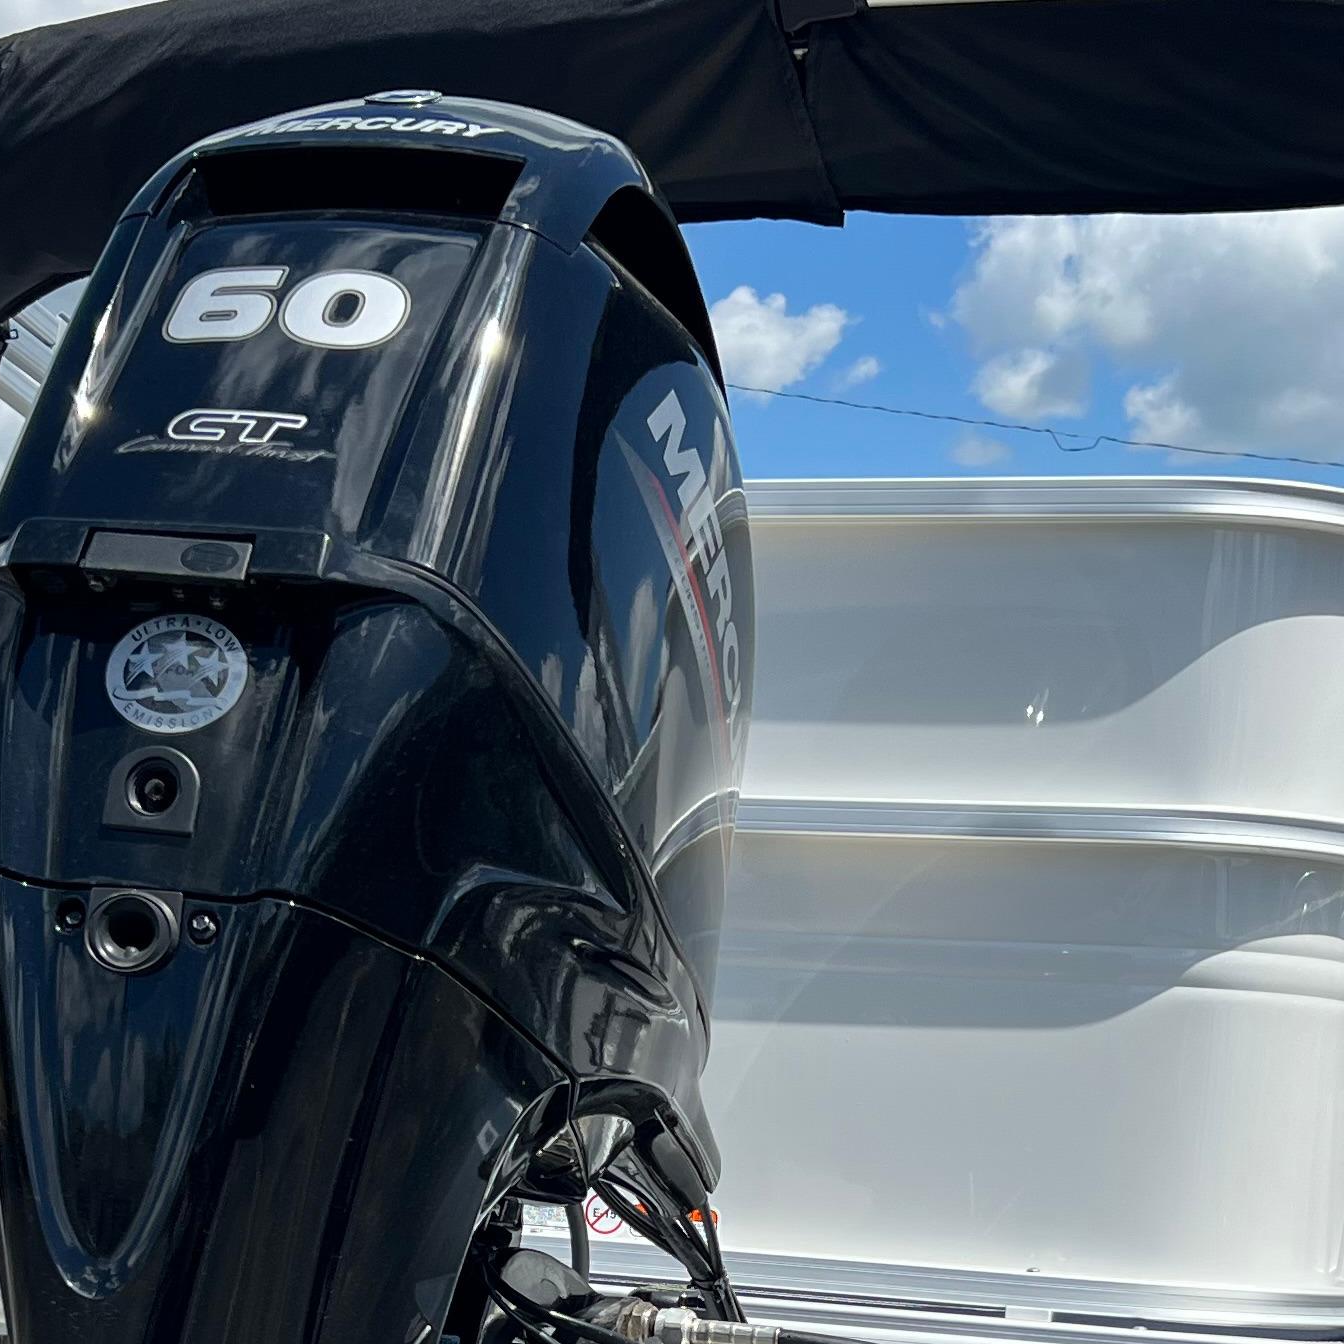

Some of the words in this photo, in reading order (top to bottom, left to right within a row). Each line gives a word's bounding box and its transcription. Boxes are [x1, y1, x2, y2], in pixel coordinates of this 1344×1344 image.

[245, 117, 505, 137] MERCURY
[162, 266, 412, 350] 60
[167, 408, 308, 443] GT
[205, 623, 239, 652] LOW
